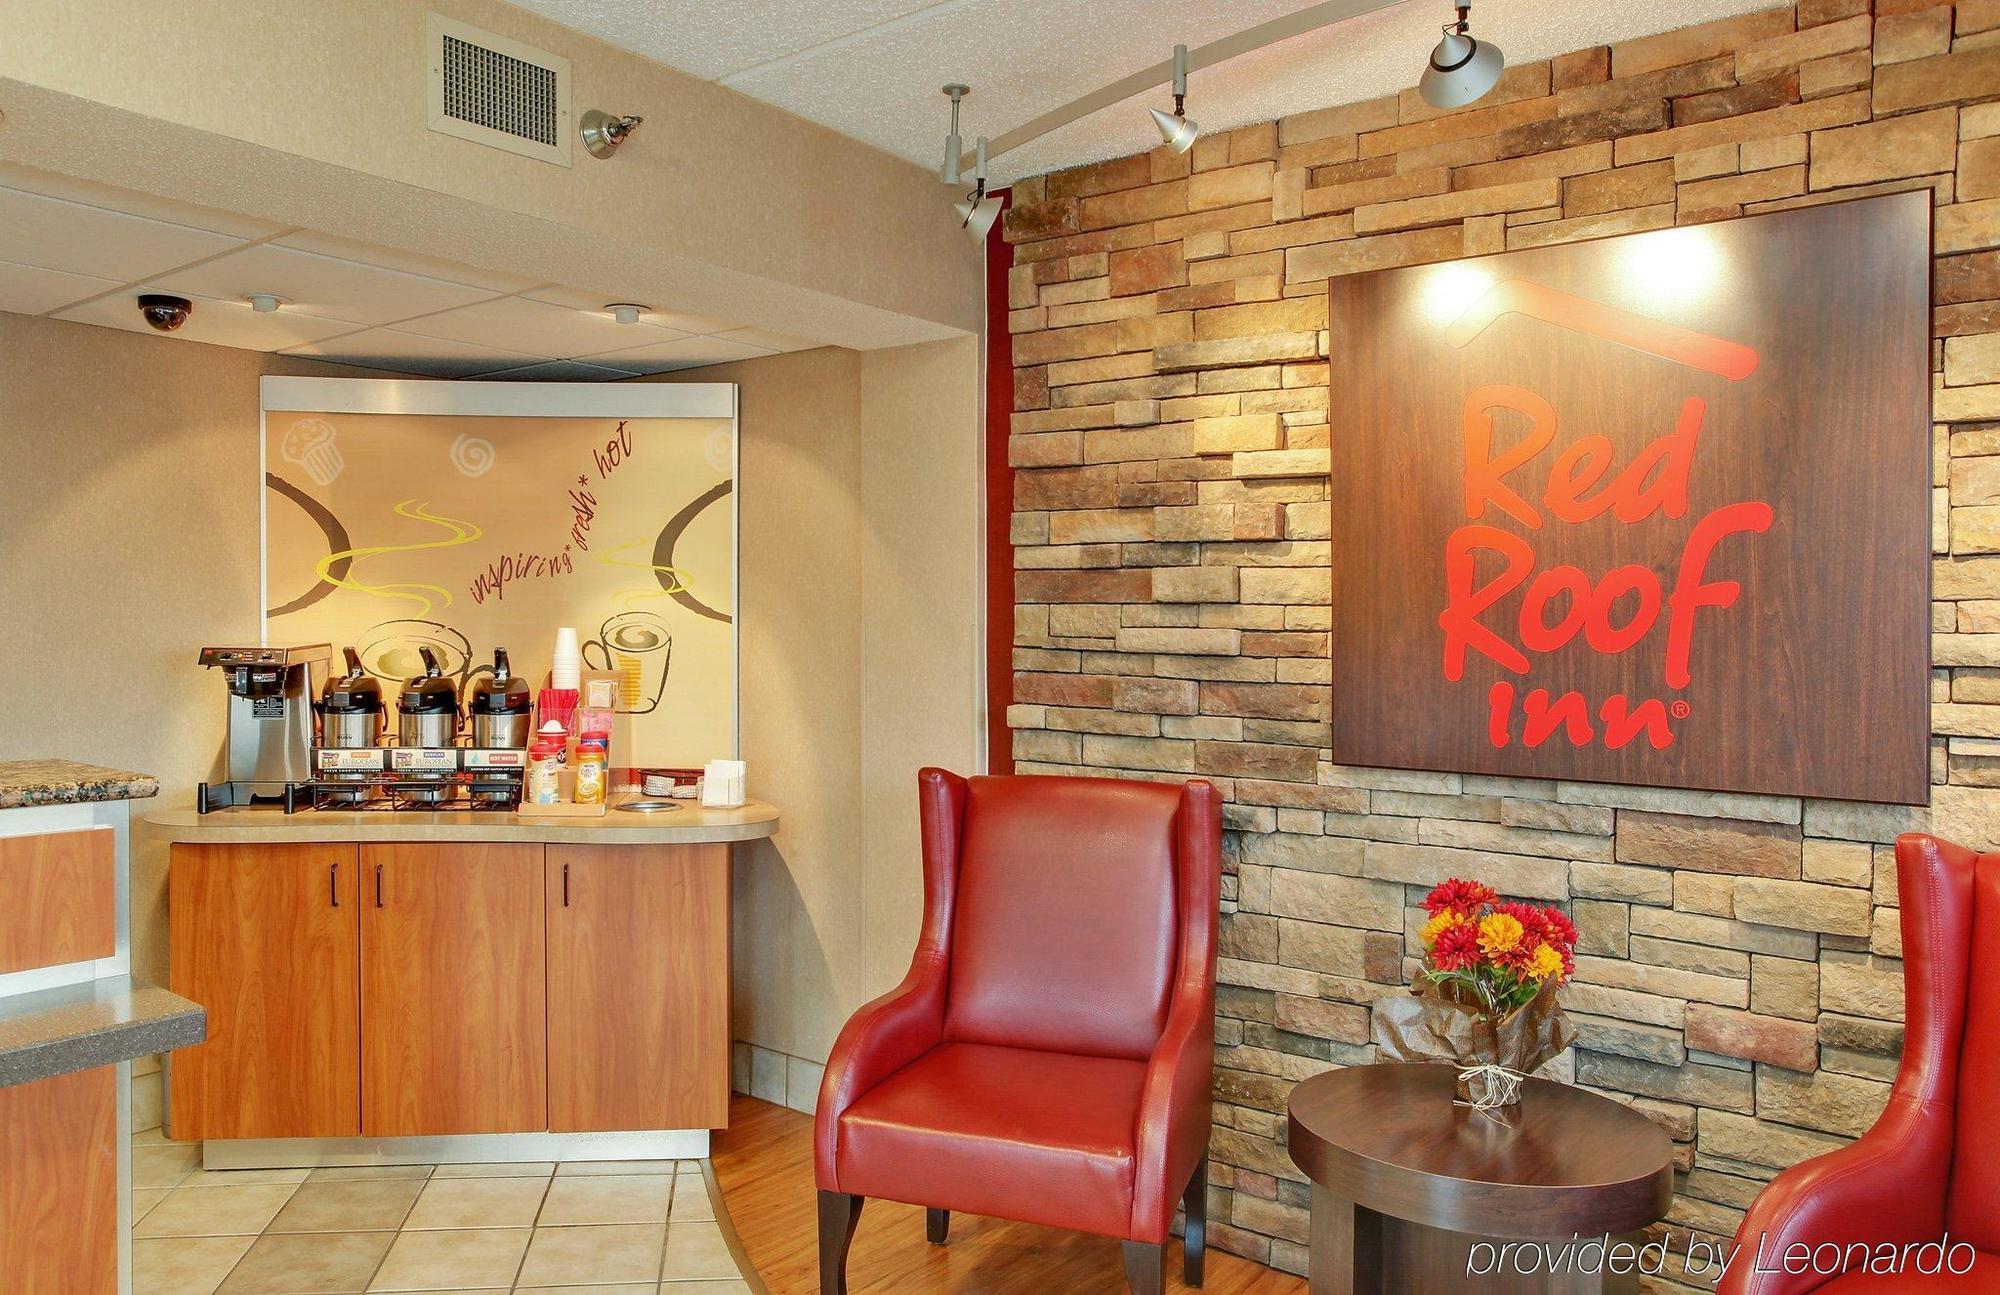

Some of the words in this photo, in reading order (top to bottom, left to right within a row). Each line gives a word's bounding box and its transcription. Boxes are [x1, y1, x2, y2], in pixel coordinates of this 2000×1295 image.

[593, 420, 632, 480] hot
[1463, 384, 1706, 530] Red
[1438, 501, 1774, 690] Roof
